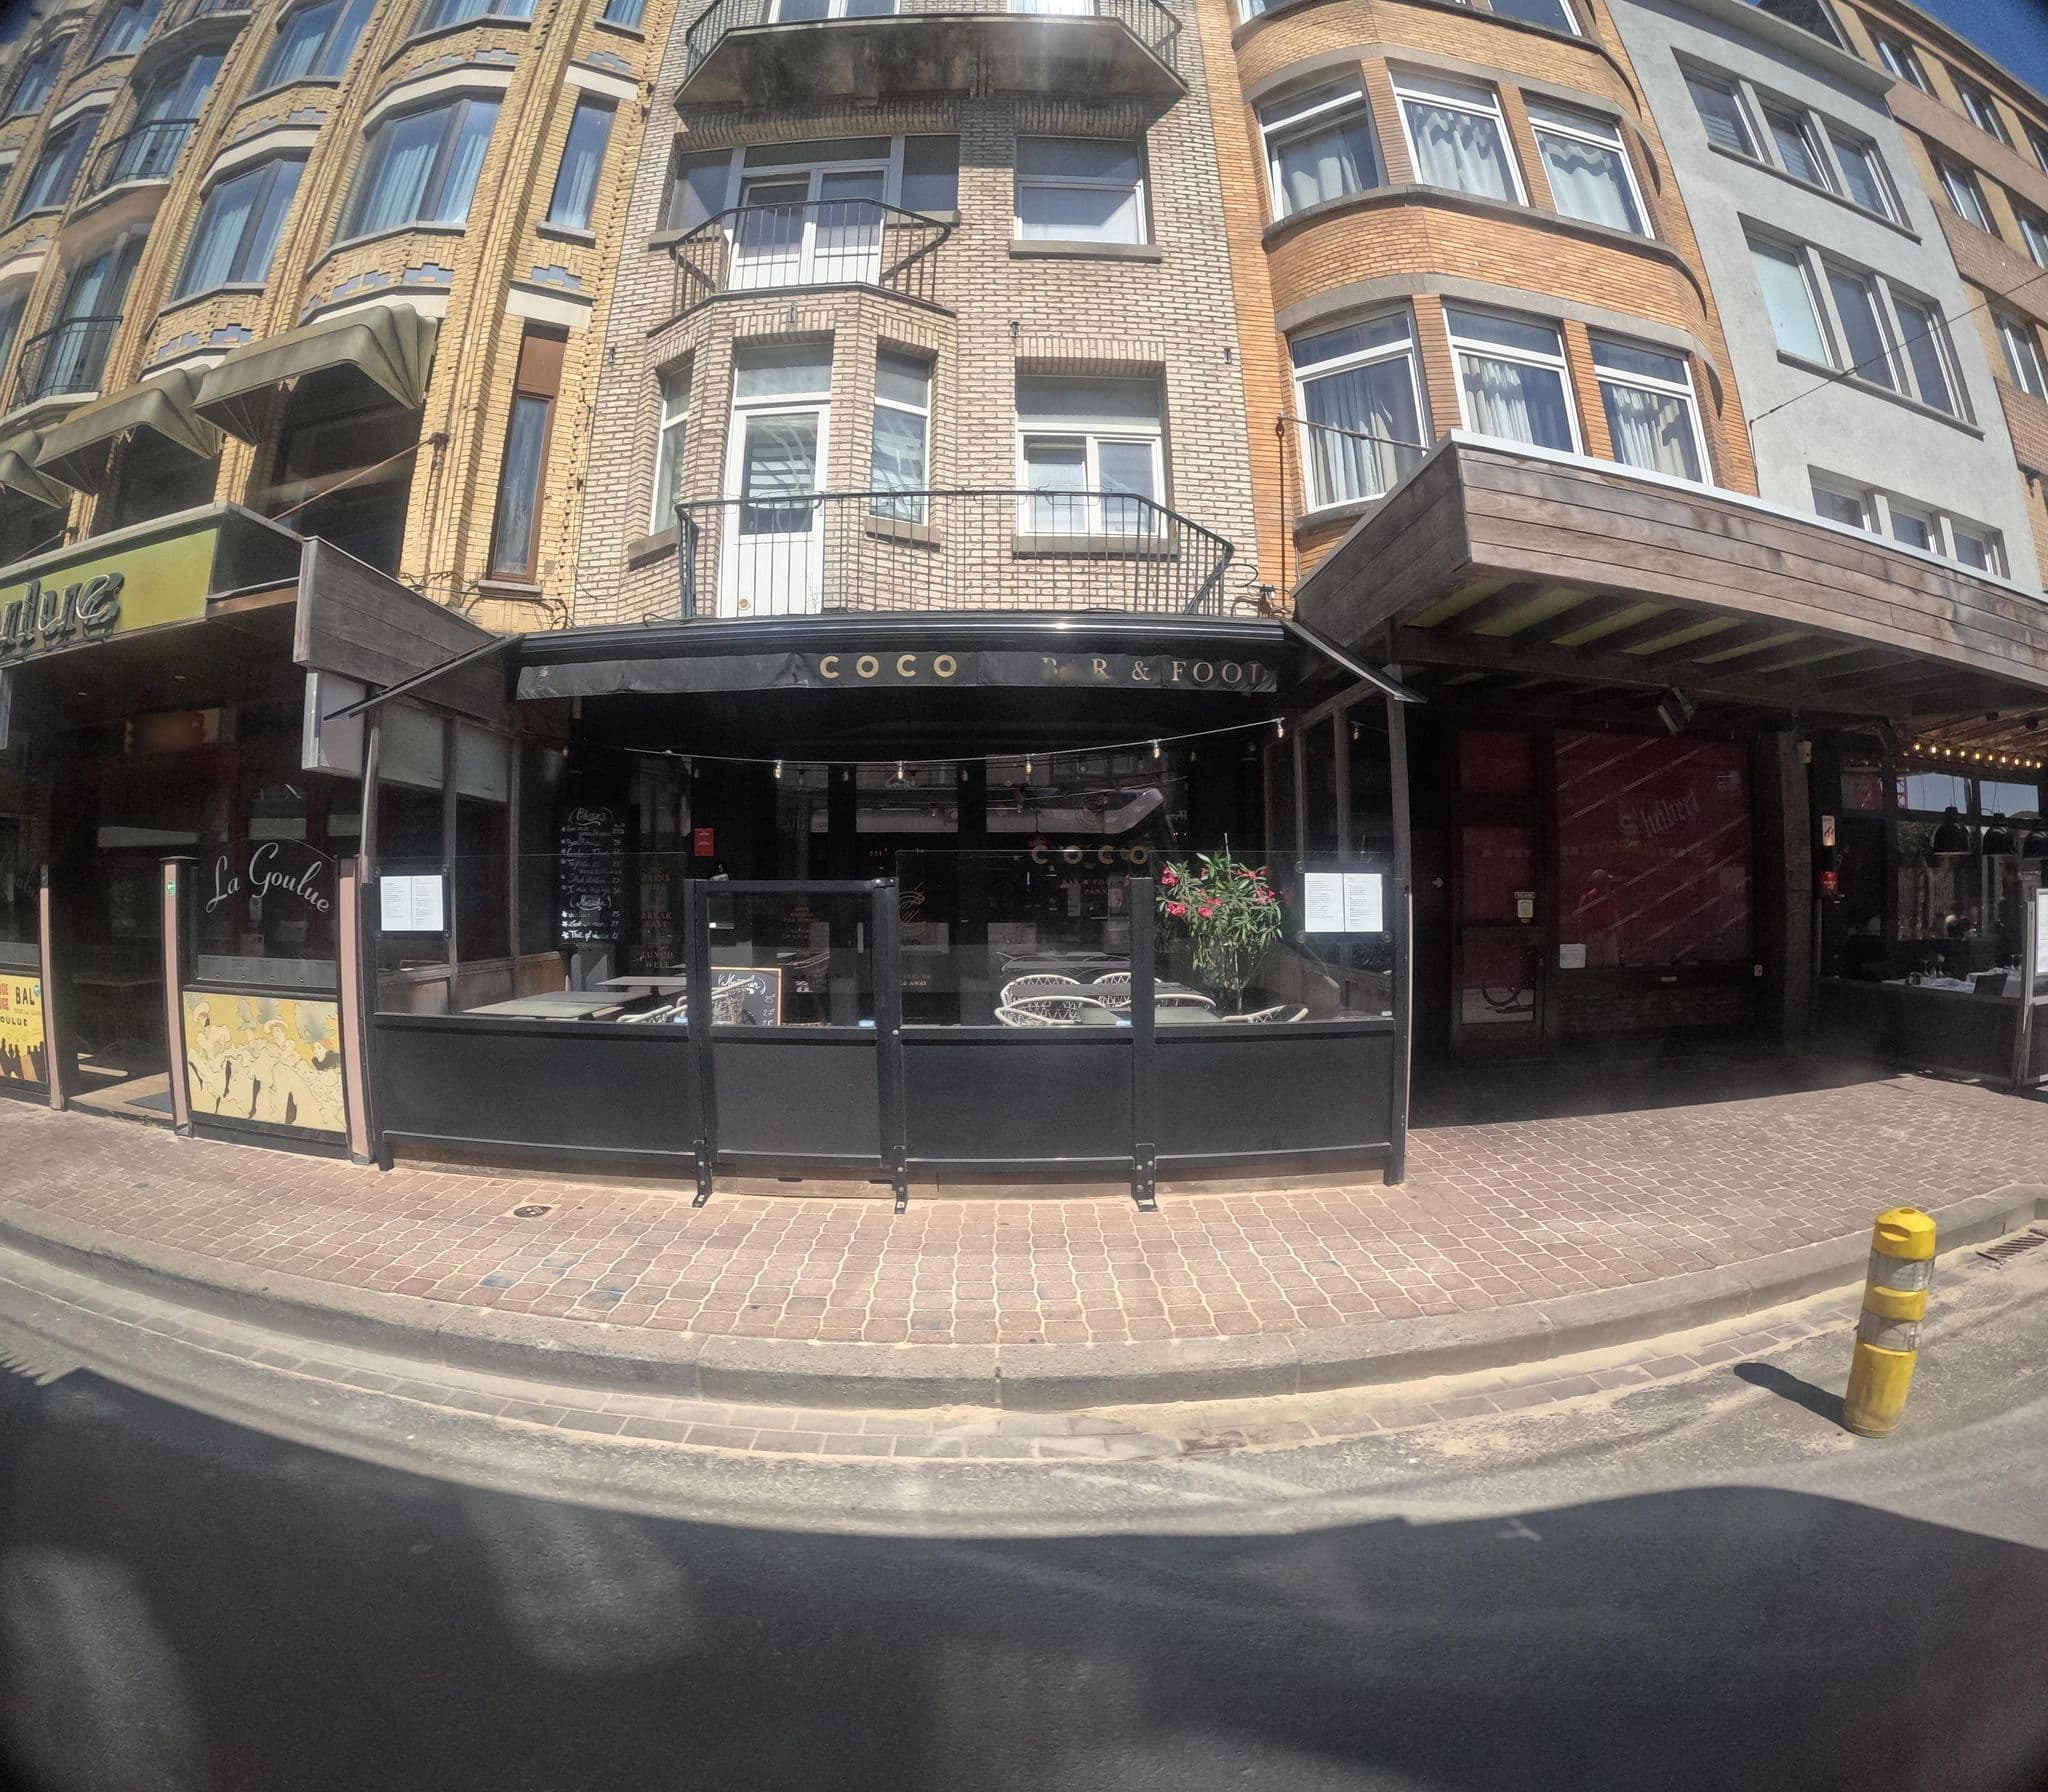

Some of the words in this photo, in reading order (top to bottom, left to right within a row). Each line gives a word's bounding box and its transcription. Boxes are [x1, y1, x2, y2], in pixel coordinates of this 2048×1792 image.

[819, 654, 958, 679] COCO
[1131, 660, 1151, 681] &
[1171, 661, 1268, 684] FOOD
[1031, 844, 1149, 865] COCO
[205, 855, 241, 913] La
[248, 842, 330, 913] Goulue
[641, 951, 674, 959] LUNCH
[15, 986, 36, 1006] BAL
